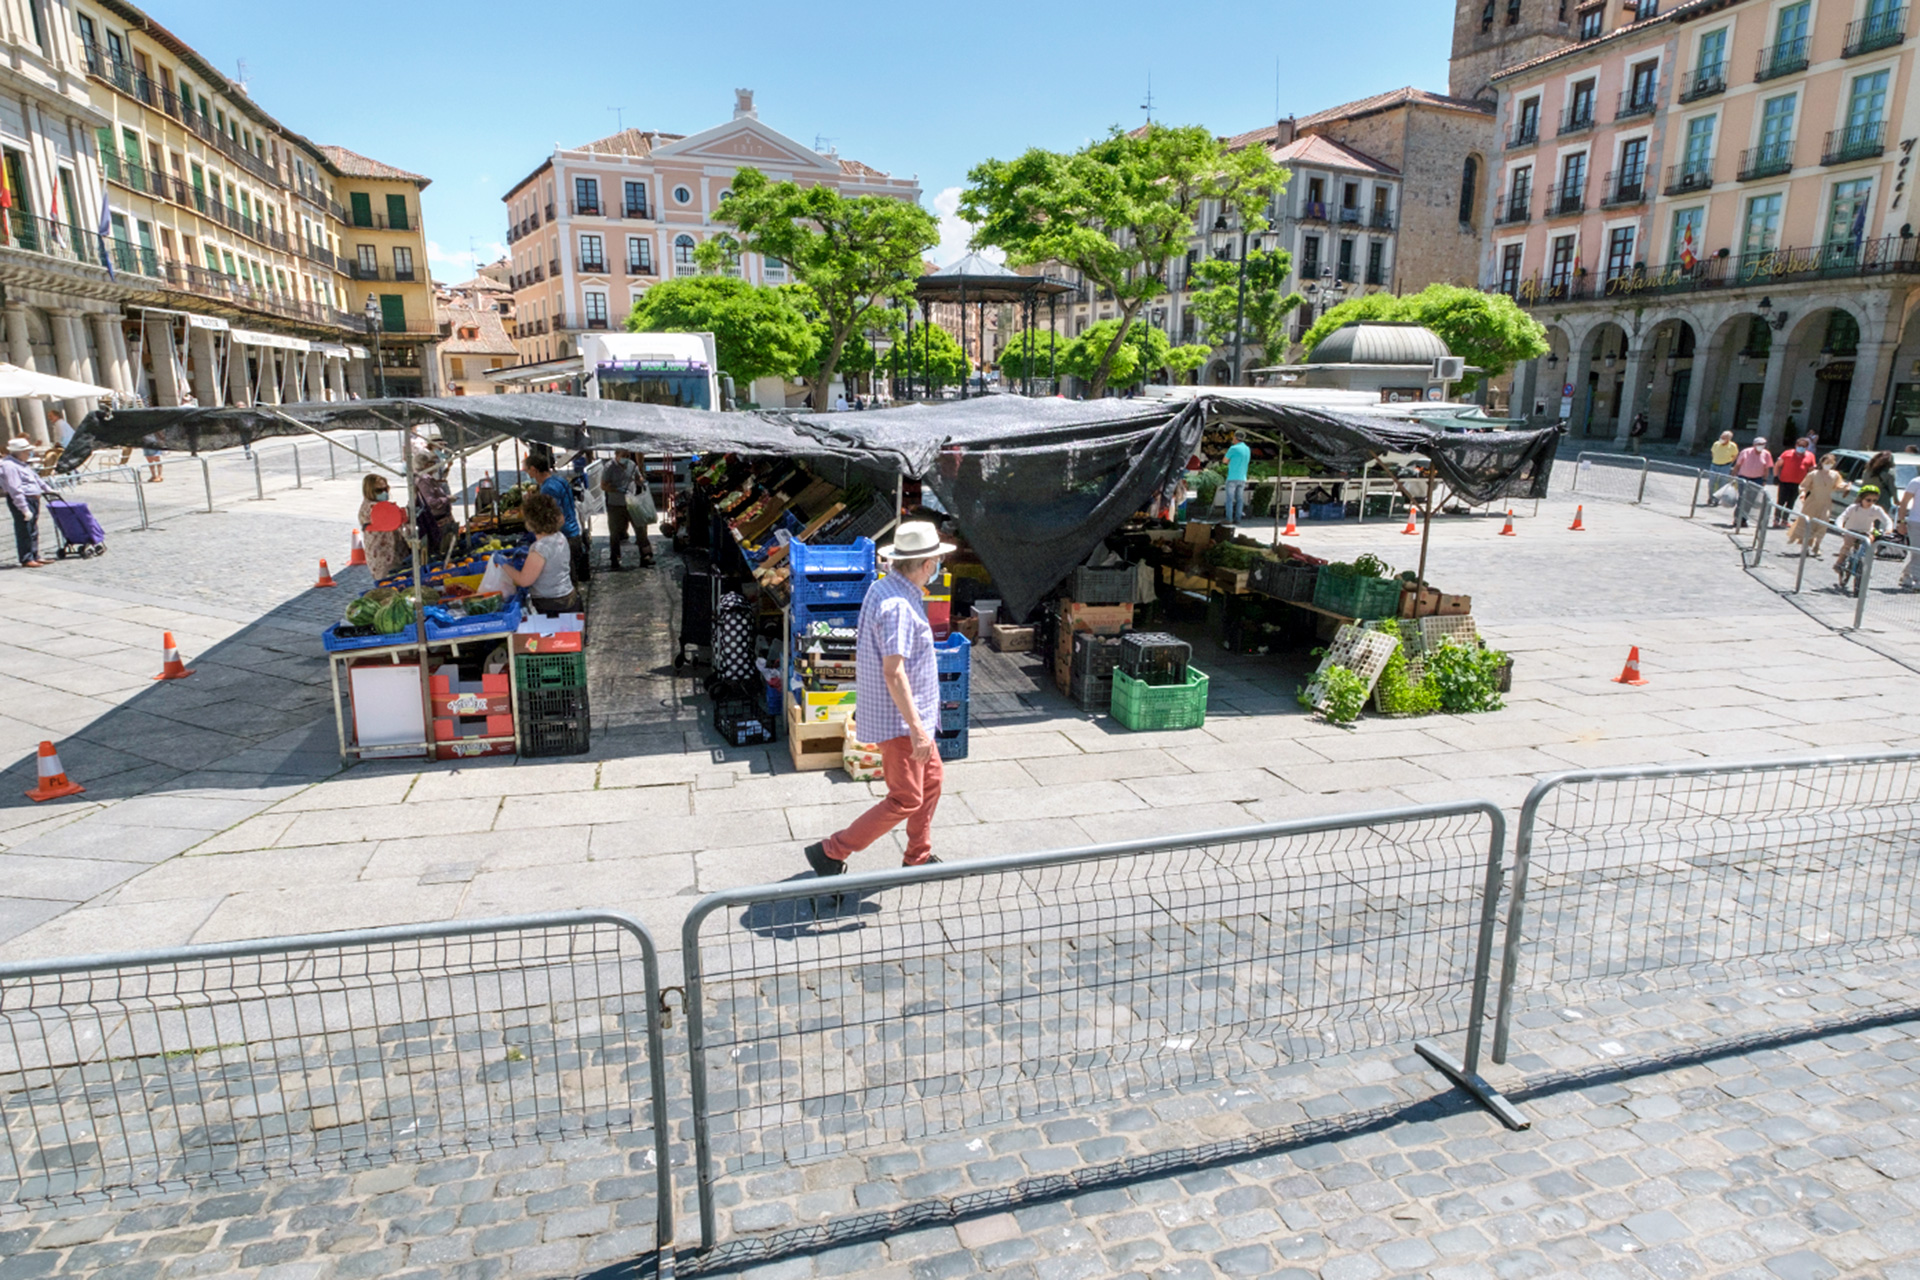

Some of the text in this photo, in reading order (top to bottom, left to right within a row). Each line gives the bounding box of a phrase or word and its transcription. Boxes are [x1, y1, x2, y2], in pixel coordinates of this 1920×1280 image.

[1891, 137, 1918, 210] Hotel
[1520, 250, 1821, 308] Hotel Infanta Isabel
